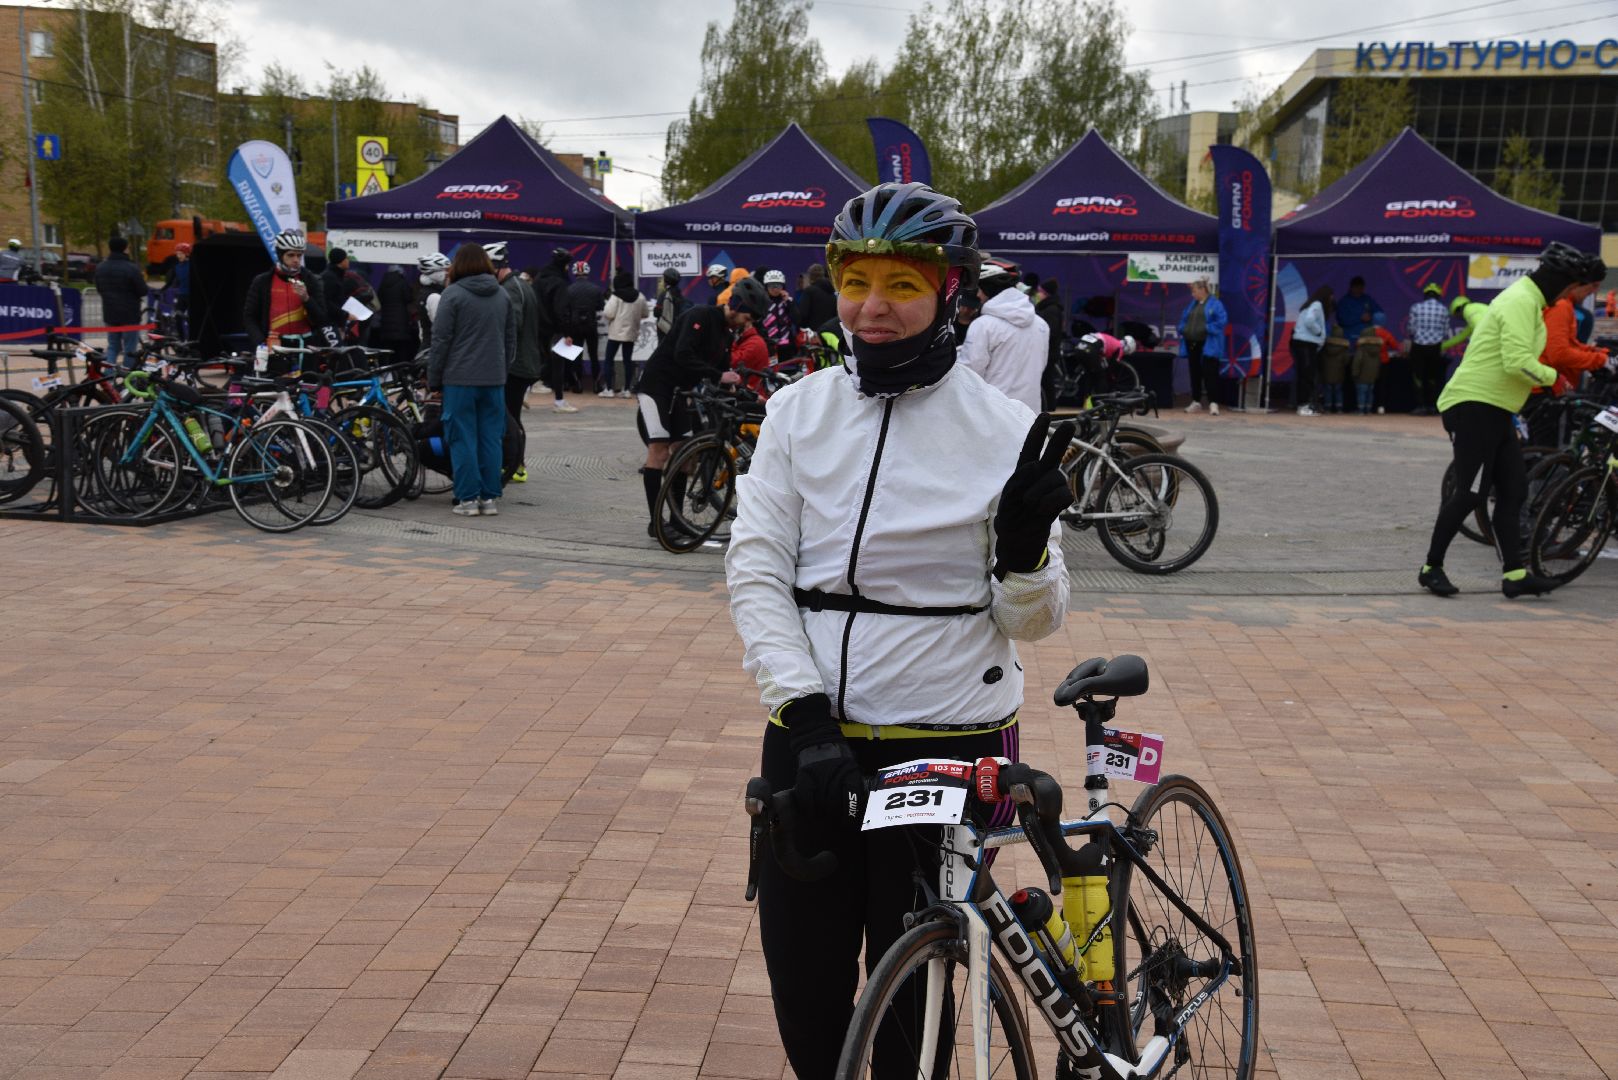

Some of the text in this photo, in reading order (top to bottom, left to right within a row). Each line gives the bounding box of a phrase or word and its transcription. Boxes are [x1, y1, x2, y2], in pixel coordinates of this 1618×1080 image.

[1355, 38, 1618, 71] КУЛЬТУРНО-С
[365, 147, 380, 158] 40
[443, 184, 509, 193] GRAN
[436, 192, 520, 200] FONDO
[746, 191, 813, 202] GRAN
[1056, 196, 1123, 207] GRAN
[1242, 170, 1252, 232] FONDO
[741, 200, 827, 209] FONDO
[1052, 205, 1139, 216] FONDO
[1231, 182, 1241, 229] GRAN
[1385, 200, 1457, 210] GRAN
[413, 209, 482, 220] БОЛЬШОЙ
[1384, 208, 1477, 218] FONDO
[685, 221, 721, 232] ТВОЙ
[723, 222, 793, 234] БОЛЬШОЙ
[998, 231, 1196, 244] ТВОЙ БОЛЬШОЙ ВЕЛОЗАЕЗД
[1331, 234, 1372, 245] ТВОЙ
[1373, 232, 1451, 244] БОЛЬШОЙ
[347, 238, 419, 250] РЕГИСТРАЦИЯ
[647, 251, 693, 261] ВЫДАЧА
[1165, 254, 1209, 263] КАМЕРА
[652, 260, 687, 269] ЧИПОВ
[1157, 263, 1216, 273] ХРАНЕНИЯ
[10, 306, 54, 319] FONDO
[1105, 752, 1130, 769] 231
[1139, 747, 1158, 766] D
[884, 765, 918, 779] GRAN
[884, 771, 930, 785] FONDO
[884, 789, 944, 811] 231
[946, 825, 956, 899] FOCUS
[979, 890, 1095, 1057] FOCUS
[1176, 990, 1209, 1028] FOCUS
